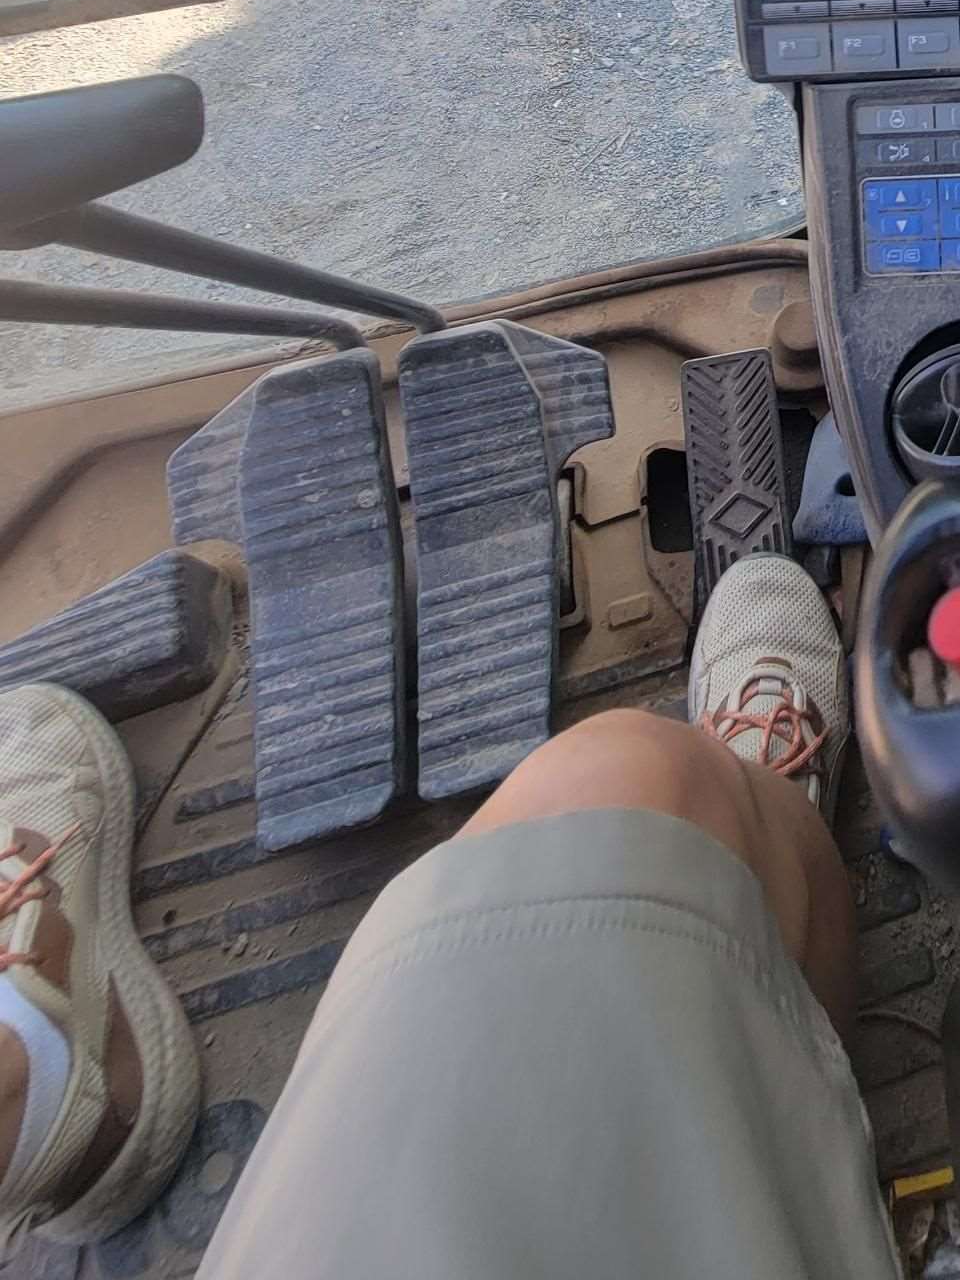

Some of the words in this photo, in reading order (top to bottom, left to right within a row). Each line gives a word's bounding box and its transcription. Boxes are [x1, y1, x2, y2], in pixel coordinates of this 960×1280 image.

[844, 37, 862, 48] F2
[910, 34, 927, 45] F3
[779, 40, 797, 51] F1
